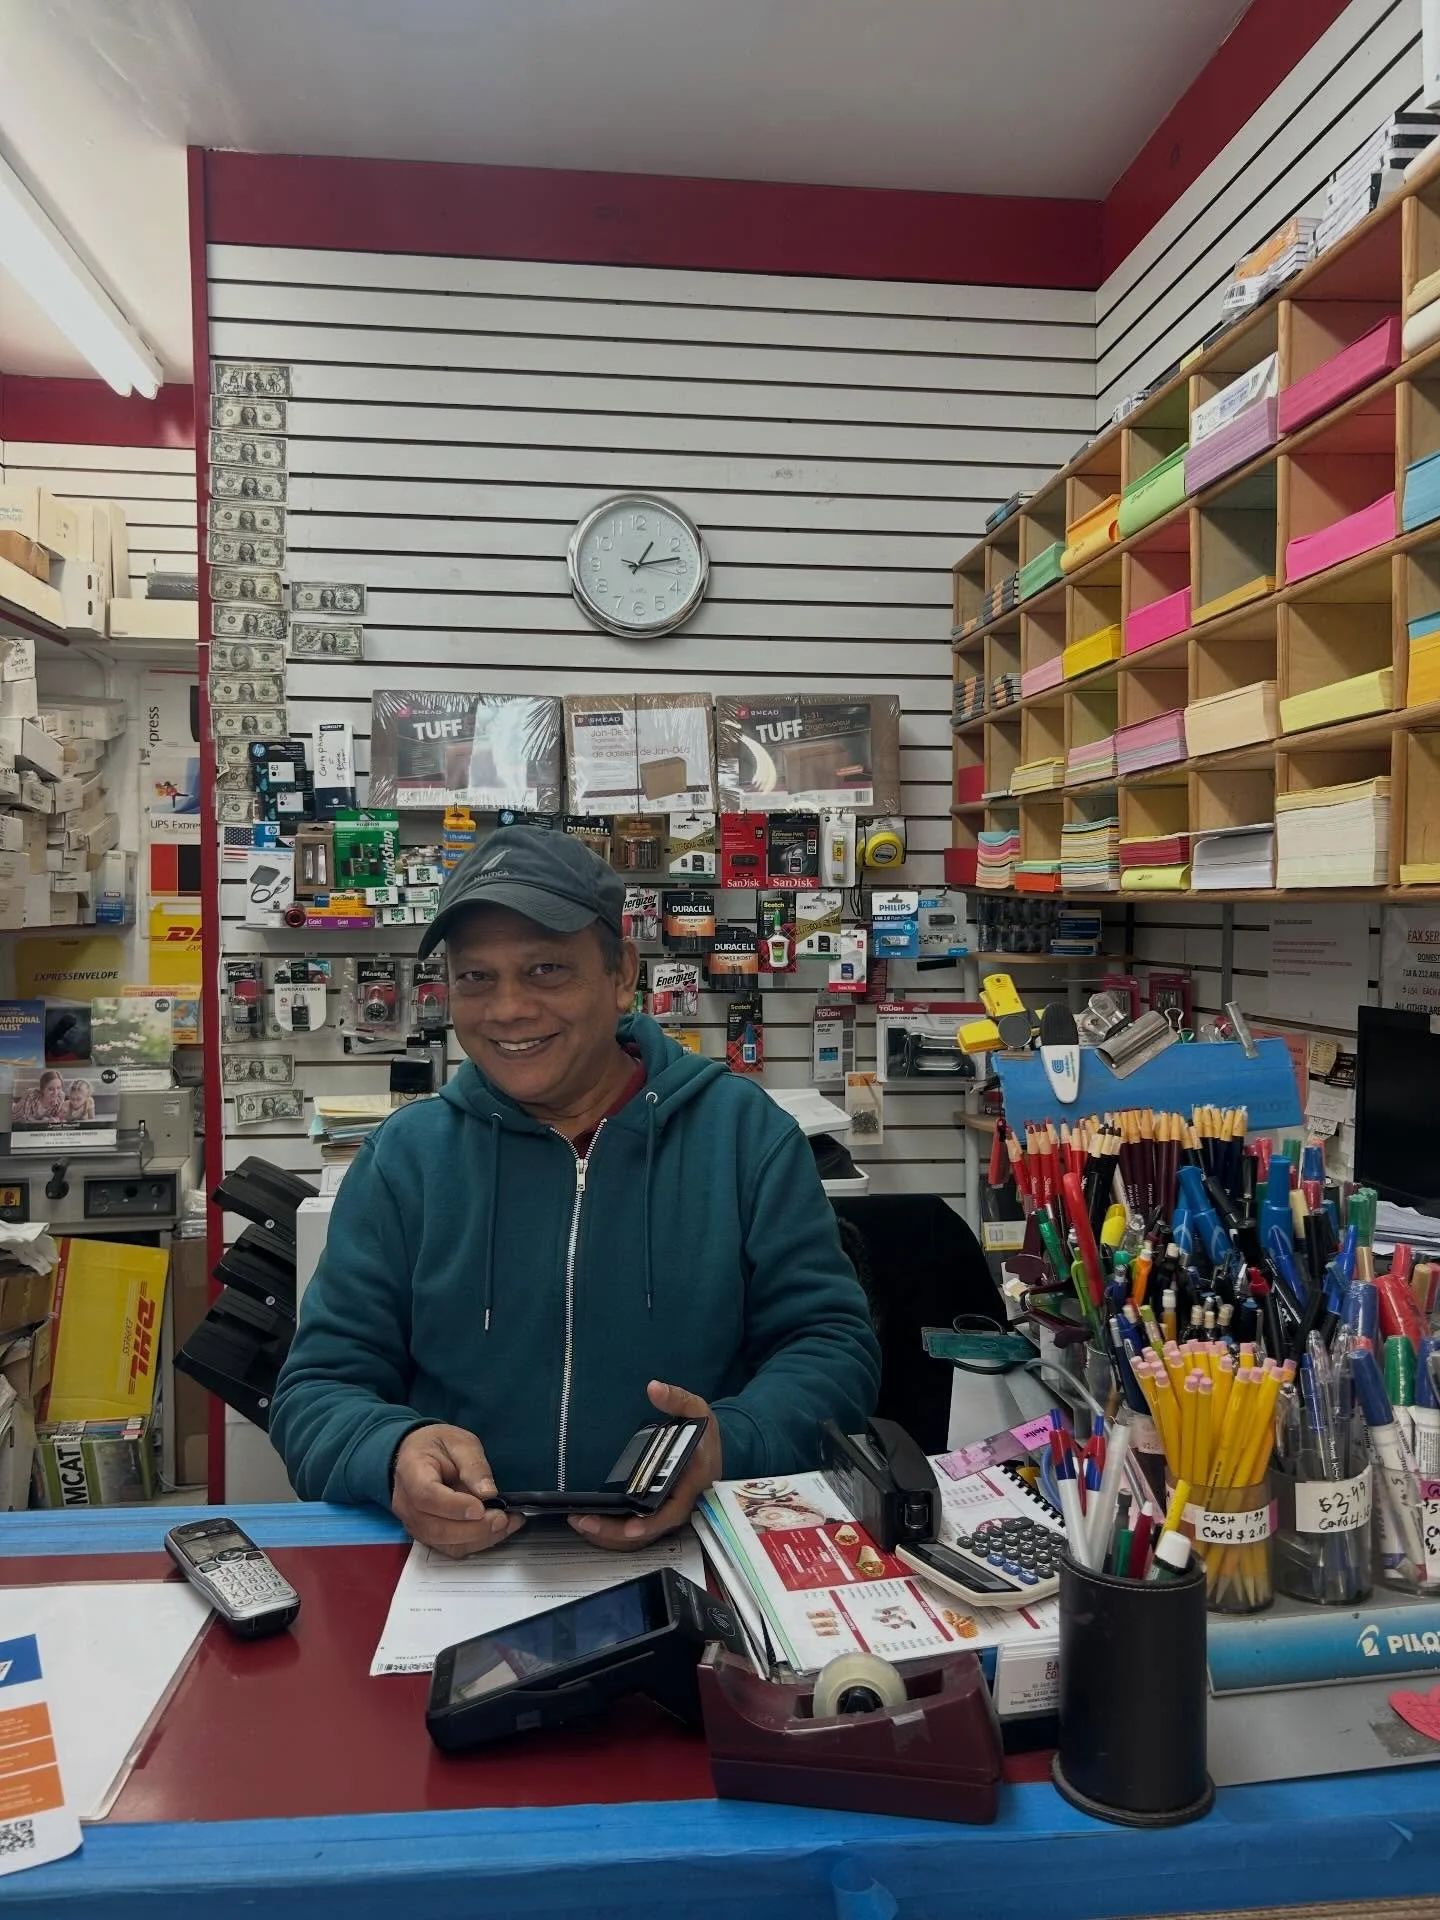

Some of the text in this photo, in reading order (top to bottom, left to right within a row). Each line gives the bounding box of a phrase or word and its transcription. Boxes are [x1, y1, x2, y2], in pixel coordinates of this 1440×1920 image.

[630, 514, 648, 531] 12
[669, 537, 682, 552] 2
[668, 580, 680, 596] 4
[613, 595, 624, 610] 7
[631, 600, 646, 616] 6
[654, 595, 666, 612] 5
[412, 718, 462, 740] TUFF
[756, 719, 803, 743] TUFF
[253, 744, 265, 758] hp
[150, 820, 169, 828] UPS
[502, 811, 514, 825] hp
[566, 826, 610, 836] DURACELL
[727, 879, 760, 888] SanDisk
[772, 878, 814, 888] SanDisk
[879, 904, 912, 912] PHILIPS
[1407, 930, 1424, 942] FAX
[34, 970, 118, 982] EXPRESSENVELOPE
[362, 970, 389, 978] Master
[656, 971, 696, 987] Energizer
[0, 1016, 40, 1024] NATIONAL
[130, 1295, 156, 1377] DHL
[1023, 1426, 1048, 1439] Helix
[62, 1447, 89, 1506] MCAT
[1204, 1514, 1235, 1525] CASH
[1202, 1526, 1232, 1540] Card
